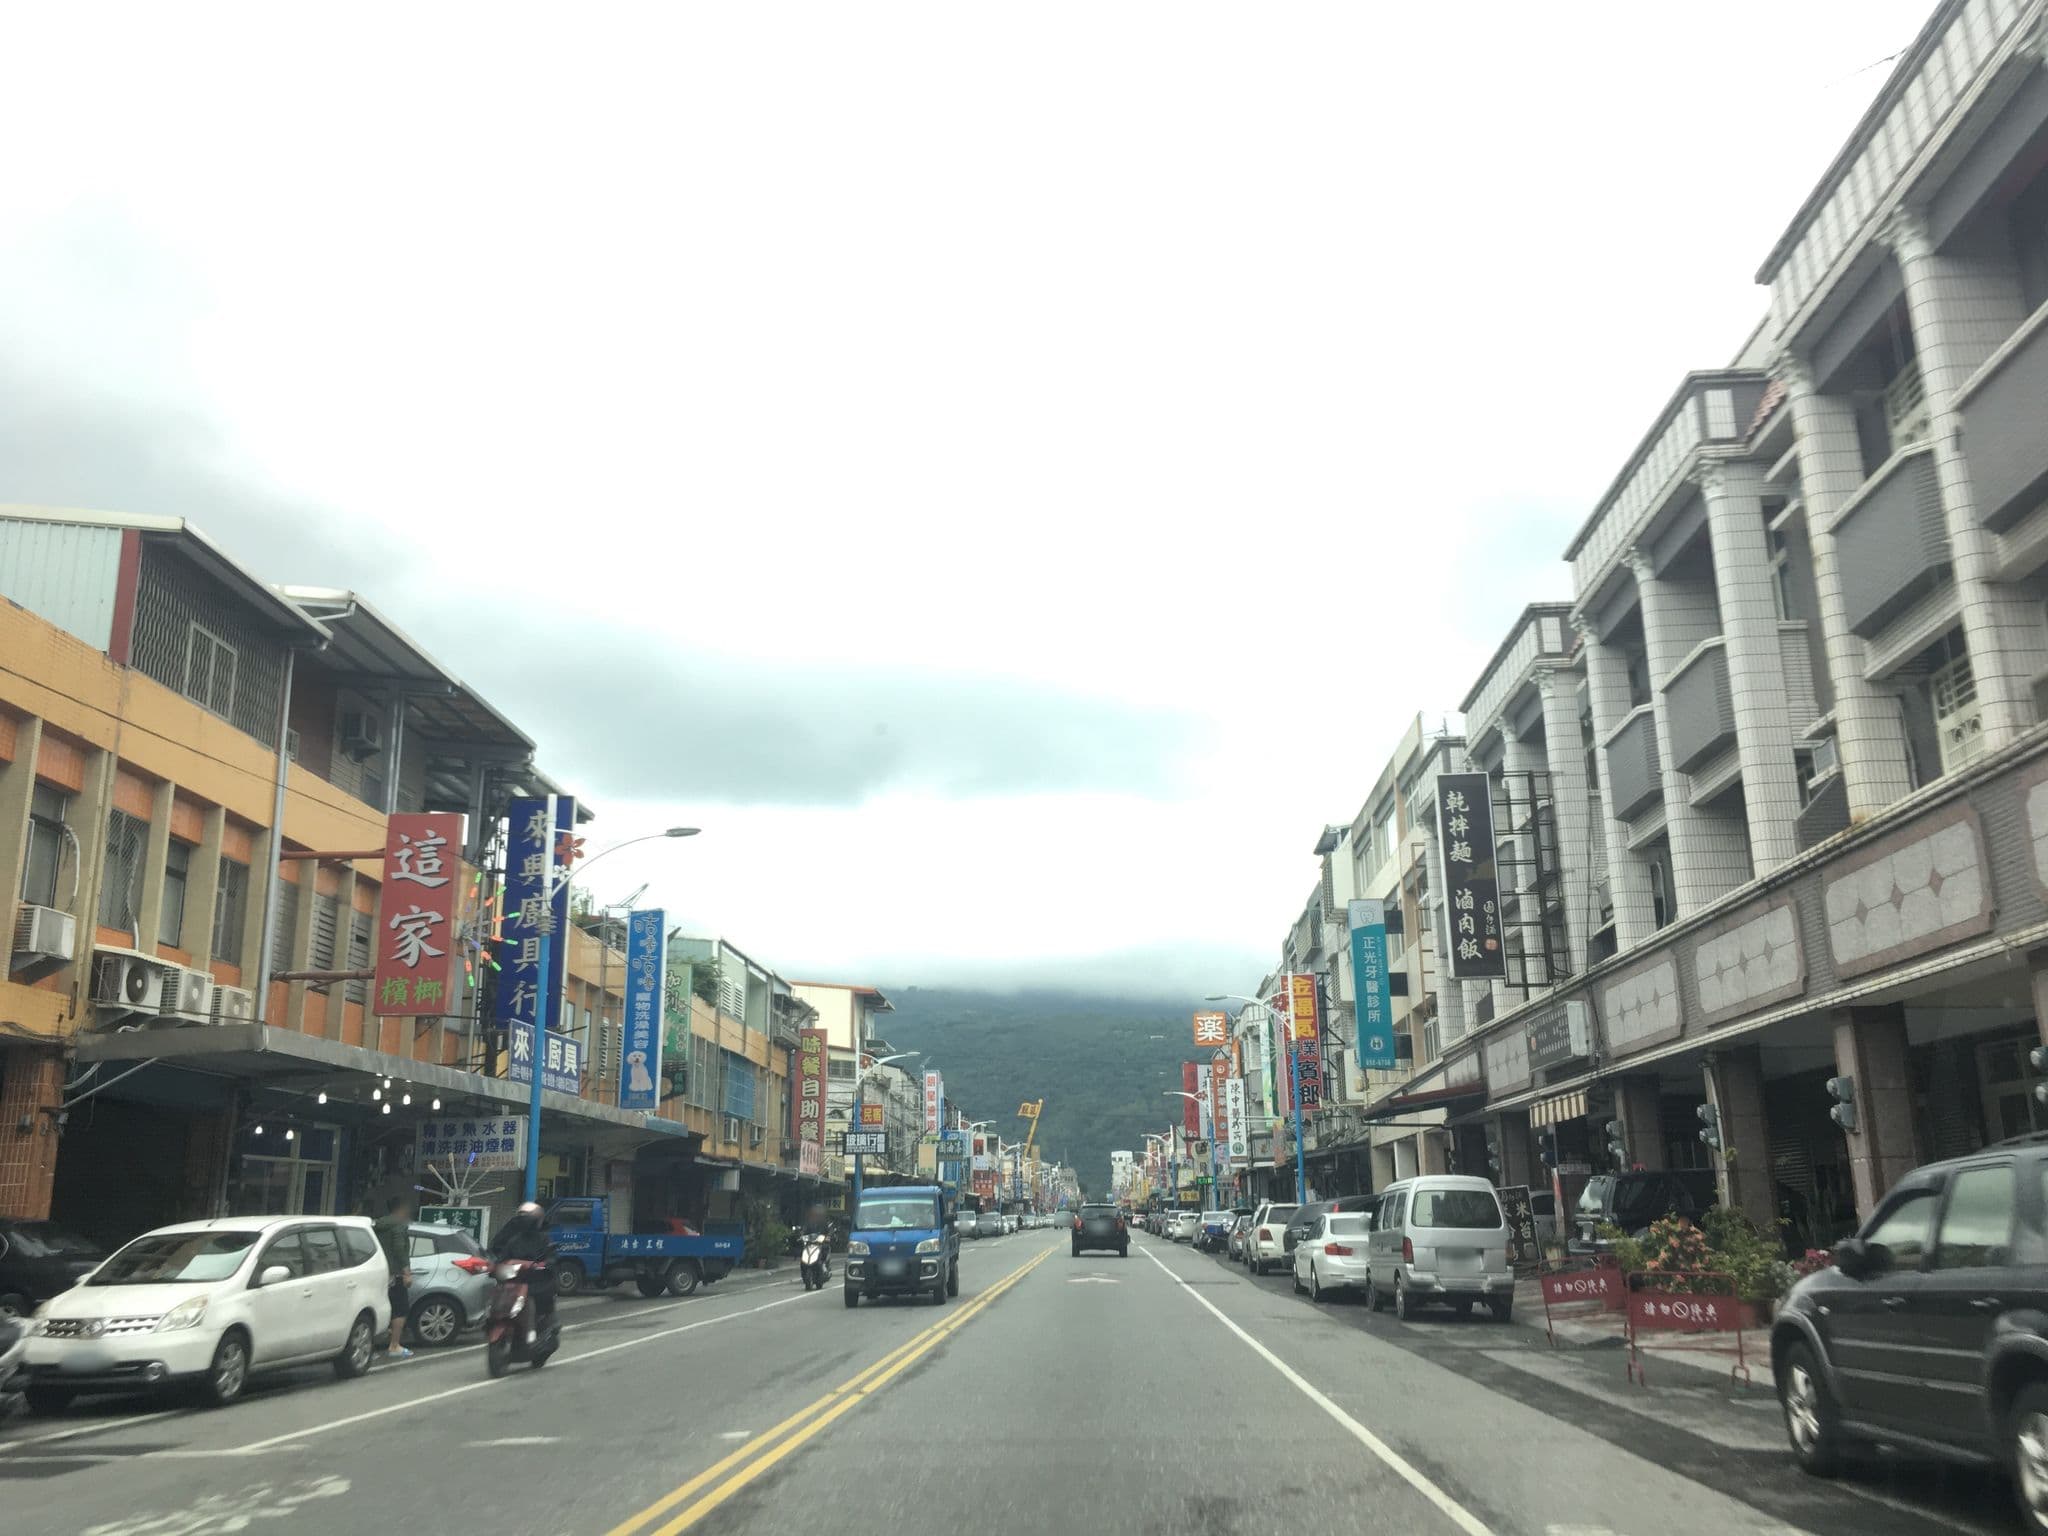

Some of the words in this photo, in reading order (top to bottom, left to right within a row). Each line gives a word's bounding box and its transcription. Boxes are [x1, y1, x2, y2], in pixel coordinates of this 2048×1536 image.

[1445, 790, 1473, 863] 乾拌麵
[390, 829, 450, 968] 這家
[1455, 888, 1483, 960] 滷肉飯
[381, 976, 443, 1007] 檳榔
[1362, 936, 1381, 1023] 正光牙醫診所
